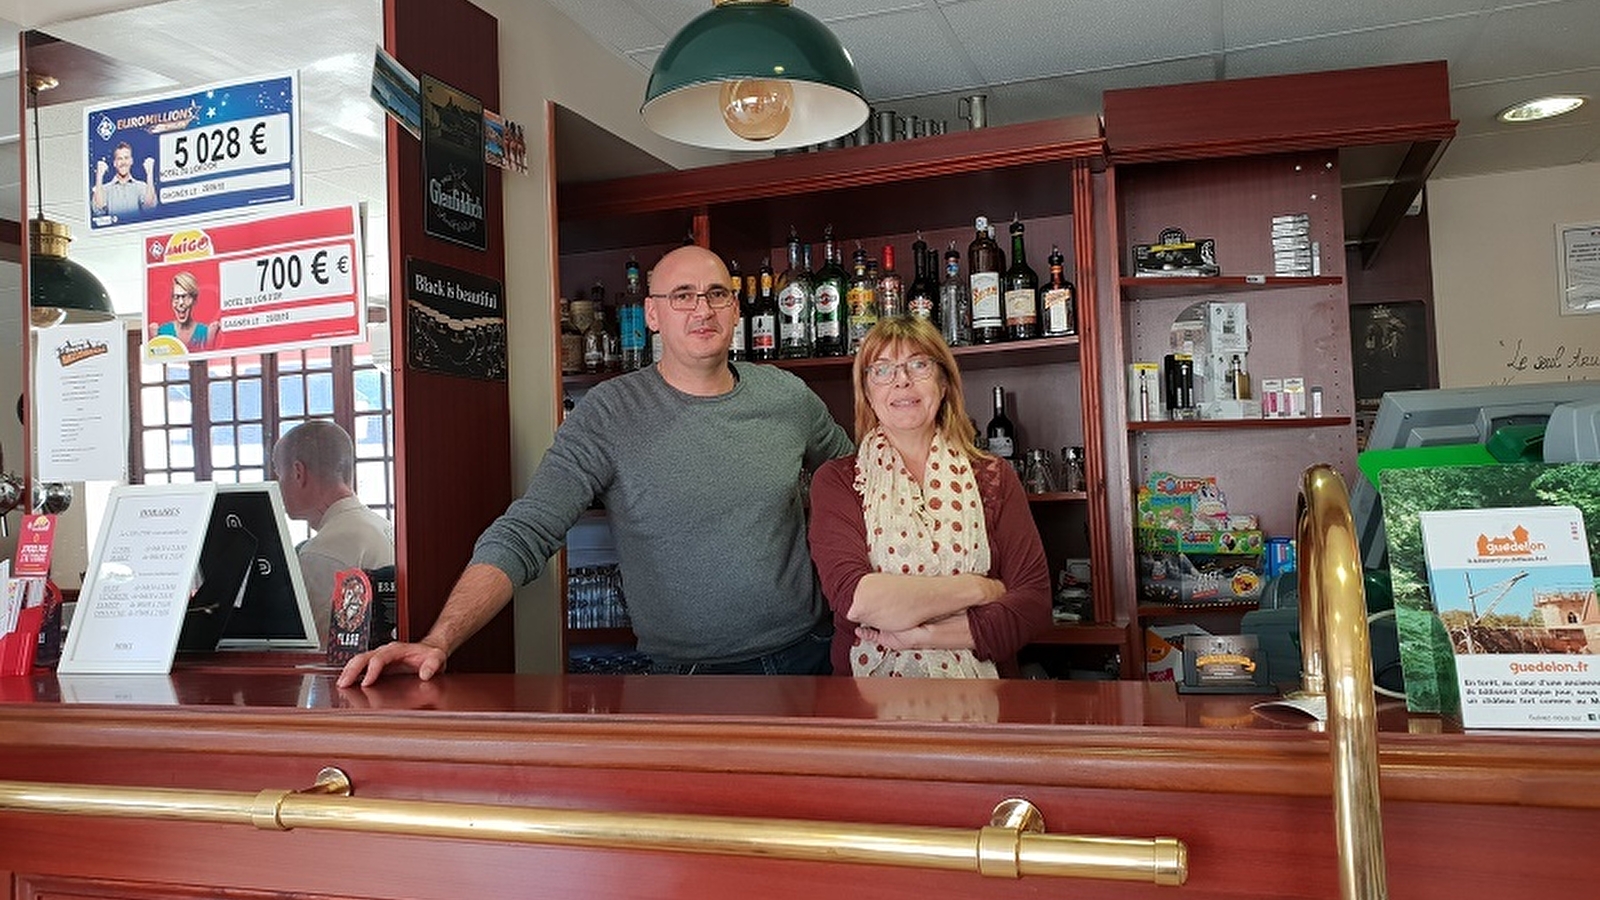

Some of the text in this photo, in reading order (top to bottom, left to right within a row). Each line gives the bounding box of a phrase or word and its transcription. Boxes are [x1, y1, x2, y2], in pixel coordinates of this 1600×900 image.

[117, 107, 193, 130] EUROMILLIONS
[174, 121, 267, 169] 5 028 €
[429, 178, 483, 220] Glenfiddich
[164, 236, 209, 255] AMIGO
[257, 250, 349, 292] 700 € €
[415, 274, 497, 309] Black is beautiful
[1509, 661, 1589, 675] guedelon.fr
[1519, 697, 1536, 705] fort
